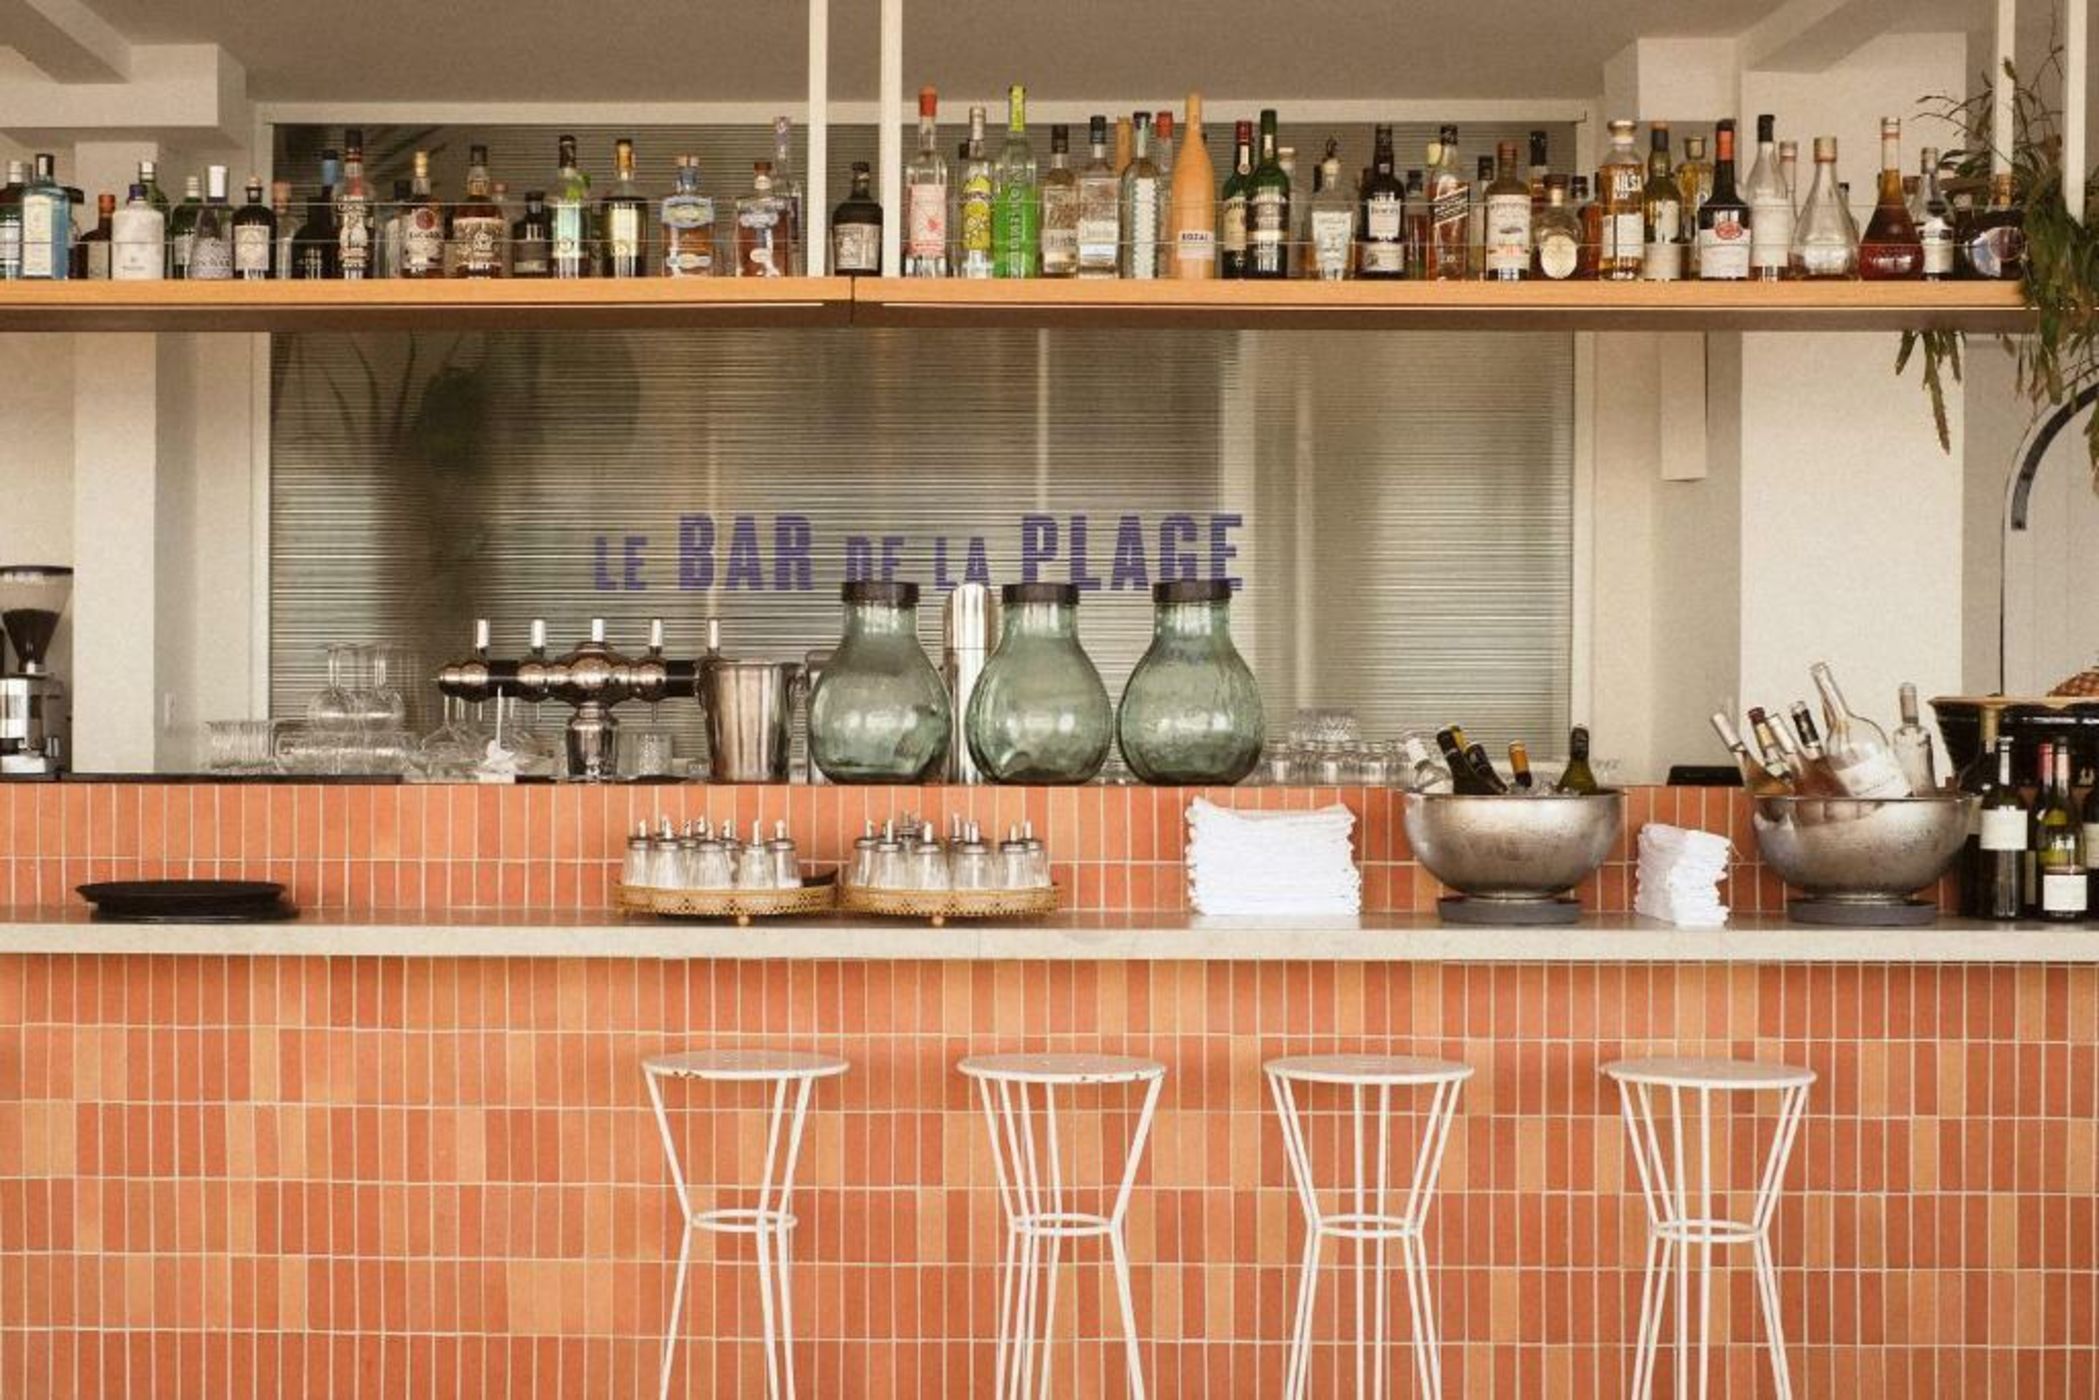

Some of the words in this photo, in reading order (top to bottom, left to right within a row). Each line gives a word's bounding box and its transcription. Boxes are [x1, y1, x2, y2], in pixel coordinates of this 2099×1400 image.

[594, 536, 647, 591] LE
[678, 515, 813, 591] BAR
[844, 536, 905, 583] DE
[934, 536, 990, 591] LA
[1020, 514, 1243, 591] PLAGE
